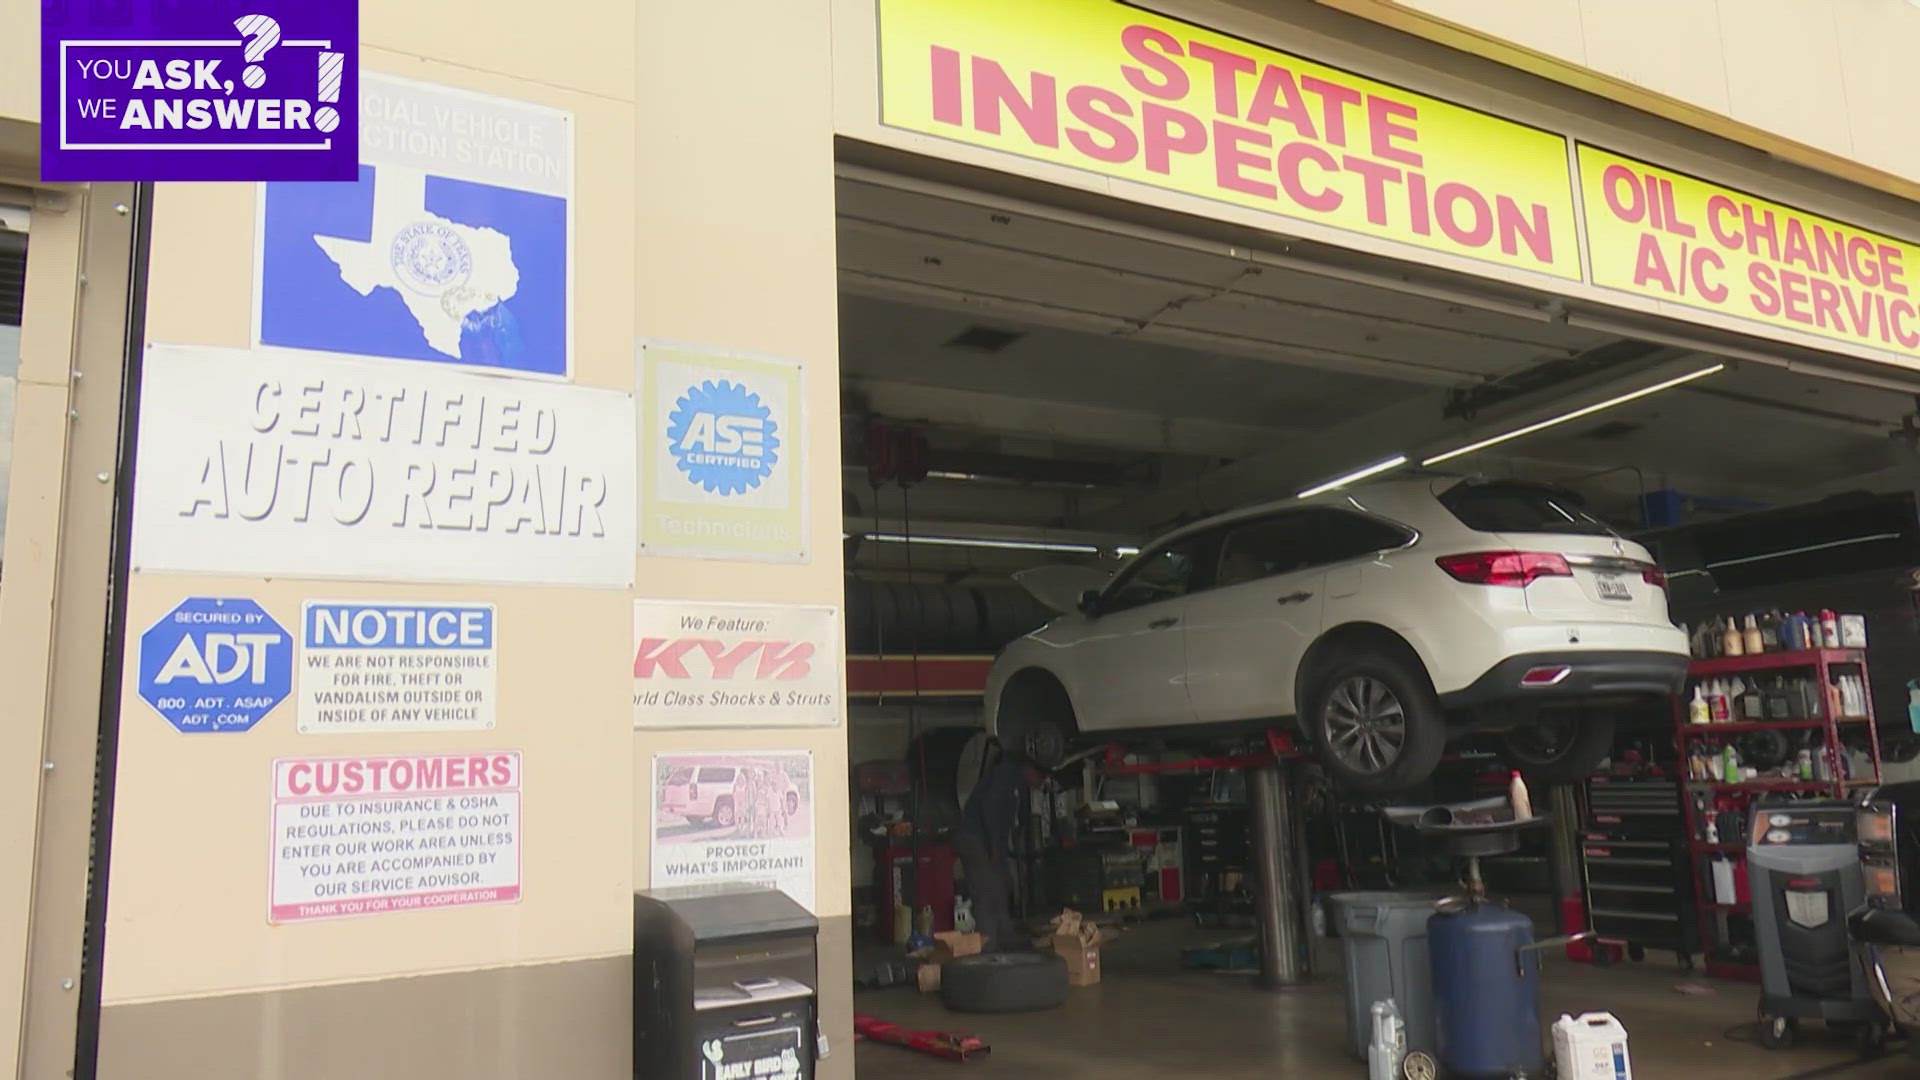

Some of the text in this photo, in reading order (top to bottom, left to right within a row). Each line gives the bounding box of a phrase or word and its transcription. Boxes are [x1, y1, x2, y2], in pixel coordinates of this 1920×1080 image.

[1120, 24, 1424, 169] STATE
[432, 103, 545, 150] VEHICLE
[361, 124, 561, 179] CTION STATION
[930, 44, 1554, 264] INSPECTION
[1602, 163, 1909, 296] OIL CHANGE
[1633, 232, 1920, 350] A/C SERVIC
[250, 379, 557, 455] CERTIFIED
[679, 411, 764, 458] ASE
[686, 452, 761, 470] CERTIFIED
[178, 439, 607, 539] AUTO REPAIR
[174, 611, 264, 624] SECURED BY
[315, 608, 485, 646] NOTICE
[680, 615, 770, 632] We Feature:
[153, 632, 282, 685] ADT
[307, 655, 490, 668] WE ARE NOT RESPONSIBLE
[634, 636, 816, 681] KYB
[333, 672, 463, 688] FOR FIRE, THEFT OR
[157, 697, 186, 710] 800
[314, 689, 483, 705] VANDALISM OUTSIDE OR
[663, 690, 705, 707] Class
[709, 690, 766, 707] Shocks
[768, 691, 781, 707] &
[785, 690, 832, 707] Struts
[318, 707, 478, 724] INSIDE OF ANY VEHICLE
[287, 755, 512, 796] CUSTOMERS
[300, 795, 499, 819] DUE TO INSURANCE & OSHA
[286, 813, 511, 840] REGULATIONS, PLEASE DO NOT
[282, 831, 513, 861] ENTER OUR WORK AREA UNLESS
[706, 843, 767, 860] PROTECT
[300, 851, 497, 878] YOU ARE ACCOMPANIED BY
[665, 856, 804, 877] WHAT'S IMPORTANT!
[314, 871, 484, 898] OUR SERVICE ADVISOR.
[299, 889, 498, 917] THANK YOU FOR YOUR COOPERATION
[753, 1054, 782, 1075] BIRD
